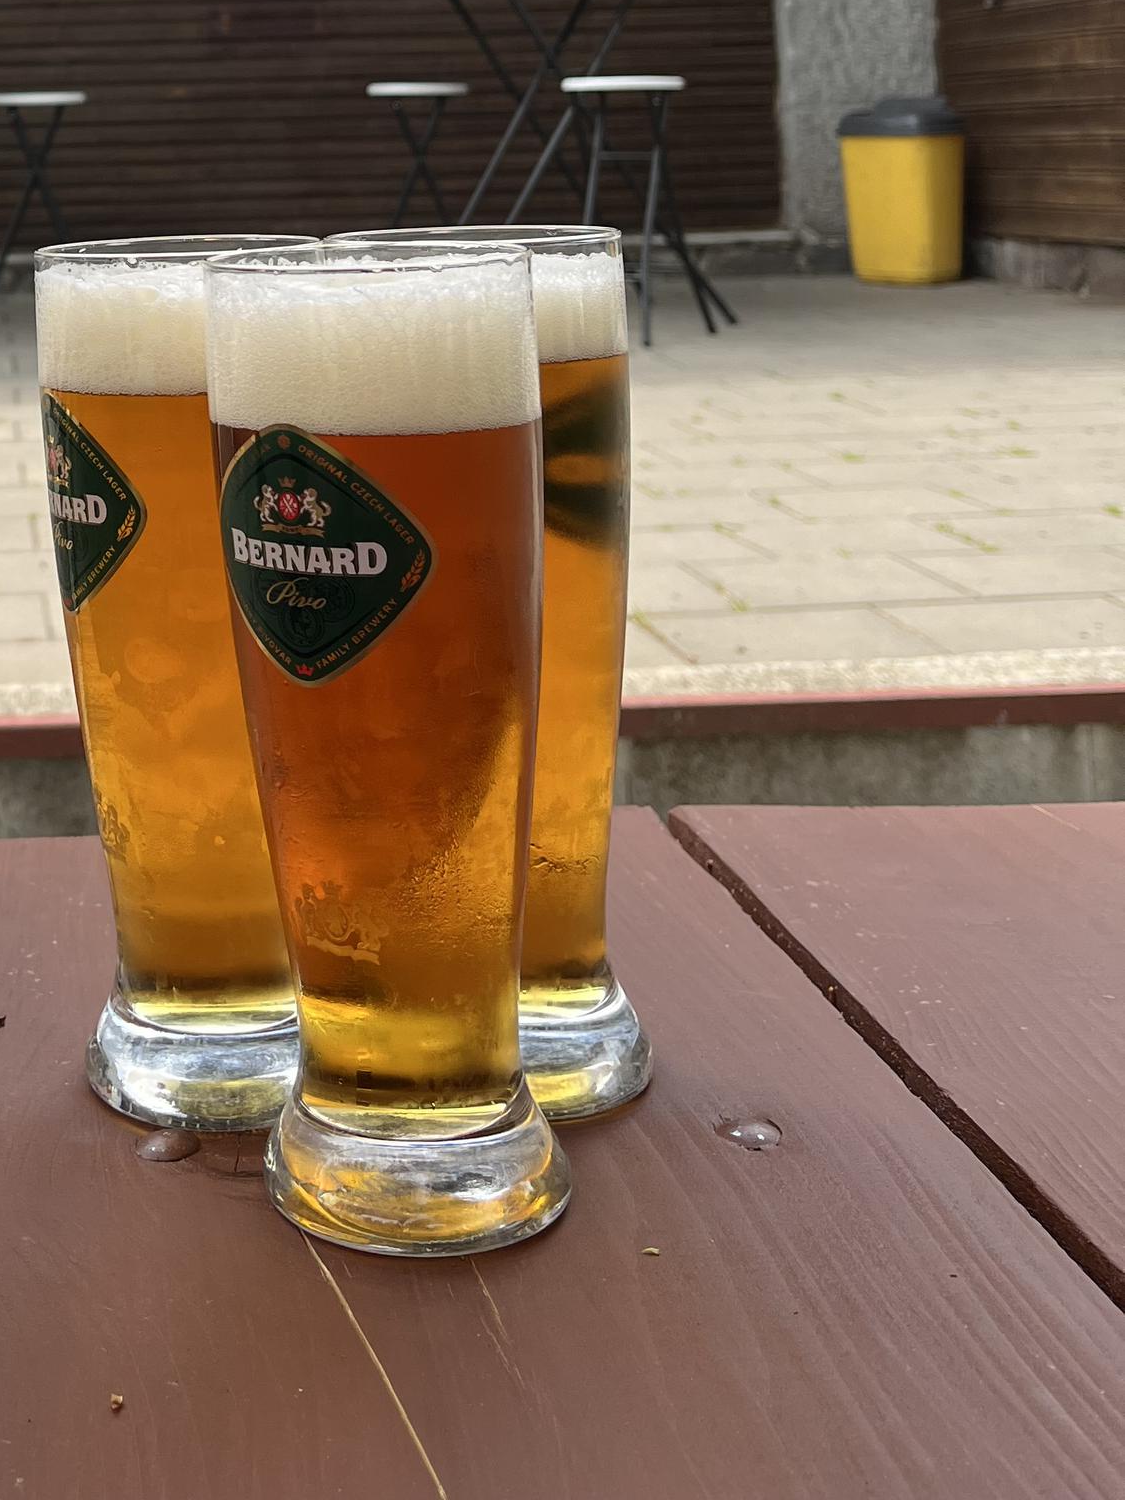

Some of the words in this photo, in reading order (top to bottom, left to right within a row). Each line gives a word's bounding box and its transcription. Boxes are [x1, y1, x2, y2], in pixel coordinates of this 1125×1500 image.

[80, 442, 104, 473] CZECH
[103, 469, 127, 501] LAGER
[298, 444, 348, 484] ORIGINAL
[350, 481, 385, 513] CZECH
[383, 512, 415, 545] LAGER
[86, 544, 116, 584] BREWERY
[231, 527, 388, 576] BERNARD
[266, 577, 327, 610] Pivo
[315, 643, 351, 669] FAMILY
[352, 598, 398, 644] BREWERY
